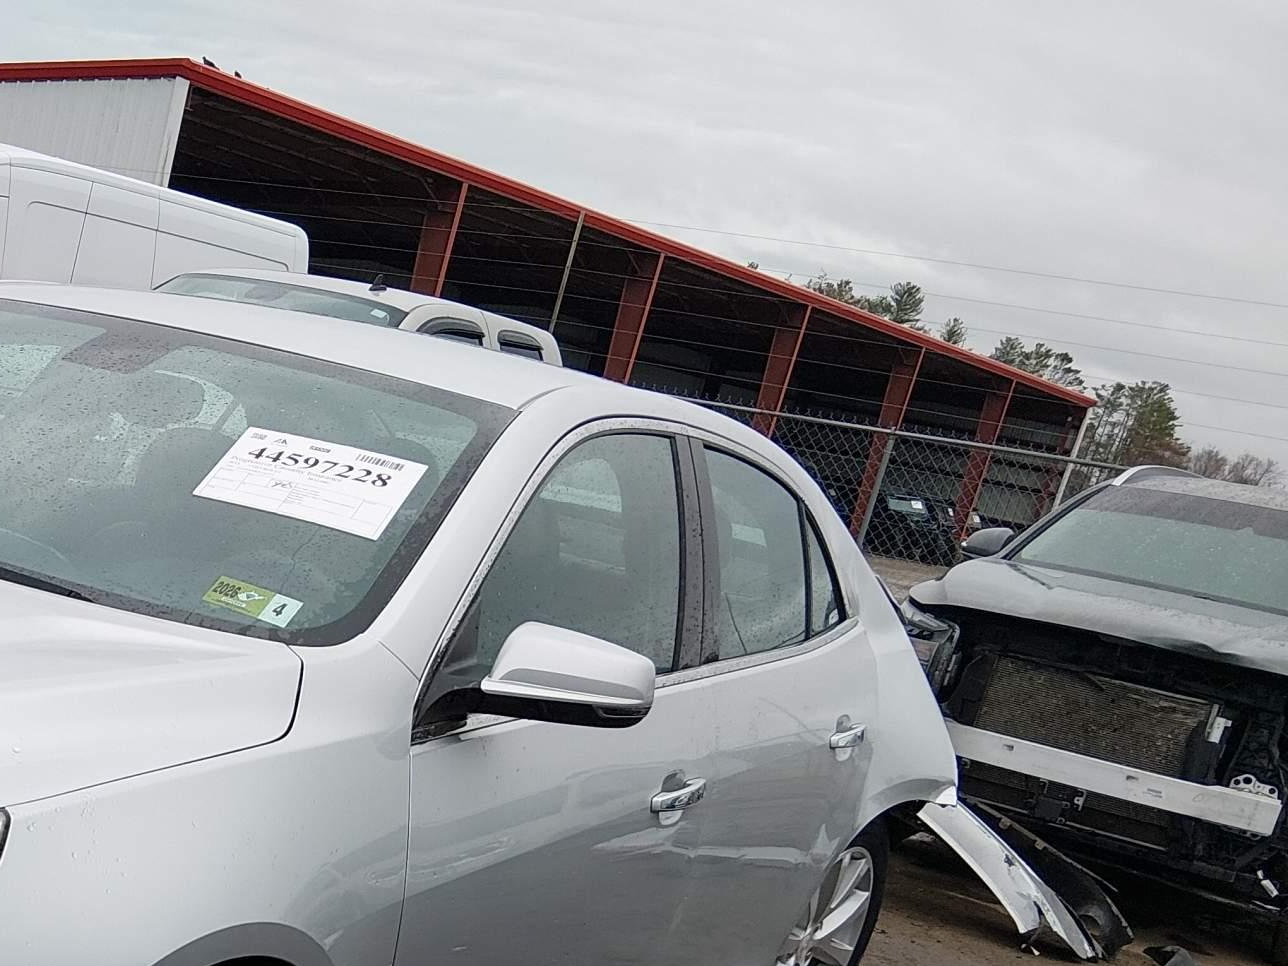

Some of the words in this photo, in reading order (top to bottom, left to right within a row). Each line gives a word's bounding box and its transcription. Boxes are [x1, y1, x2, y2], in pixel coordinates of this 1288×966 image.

[248, 447, 392, 487] 44597228
[212, 581, 241, 598] 2026
[272, 603, 288, 616] 4
